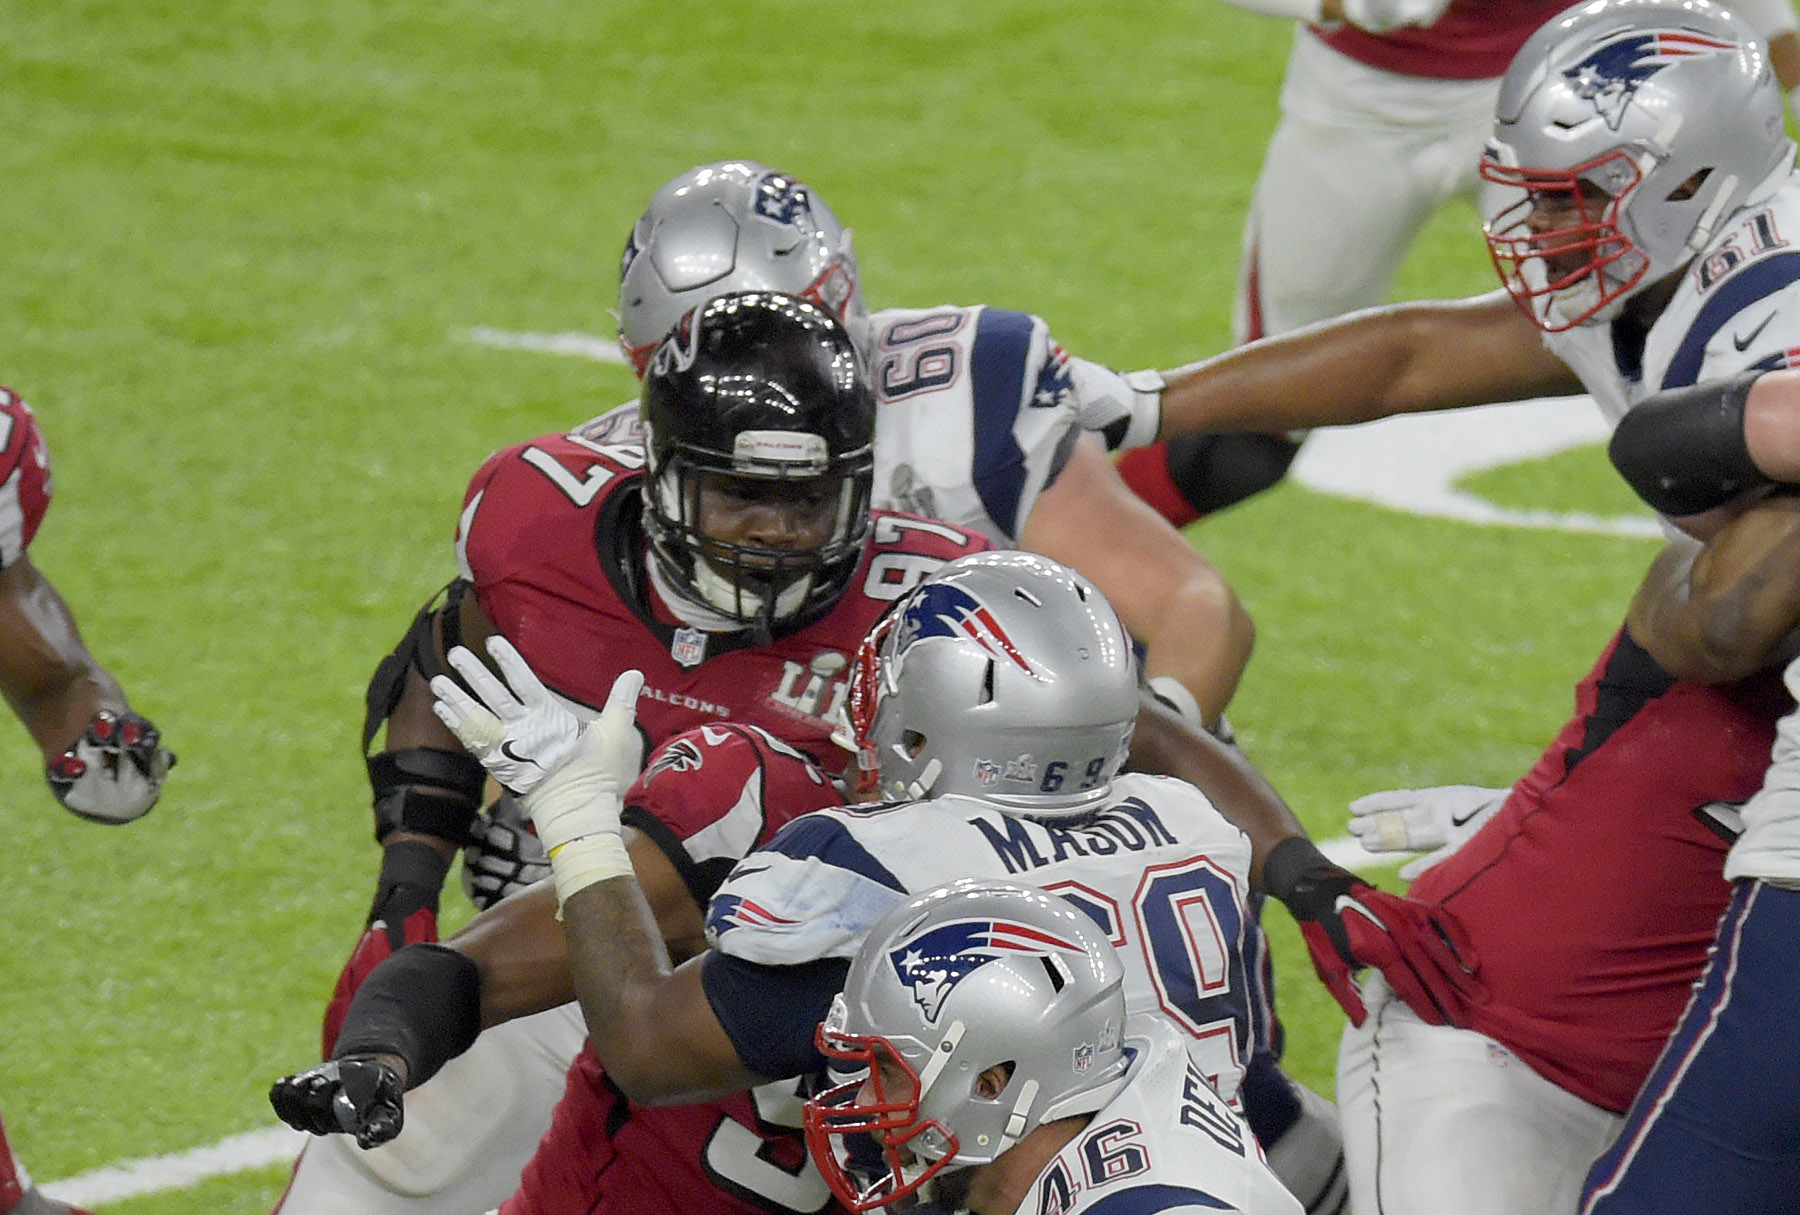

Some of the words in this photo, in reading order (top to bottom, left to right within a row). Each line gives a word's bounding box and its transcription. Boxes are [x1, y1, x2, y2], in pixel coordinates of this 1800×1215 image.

[876, 310, 970, 405] 60
[639, 685, 732, 719] ALCONS
[966, 795, 1179, 875] MASON
